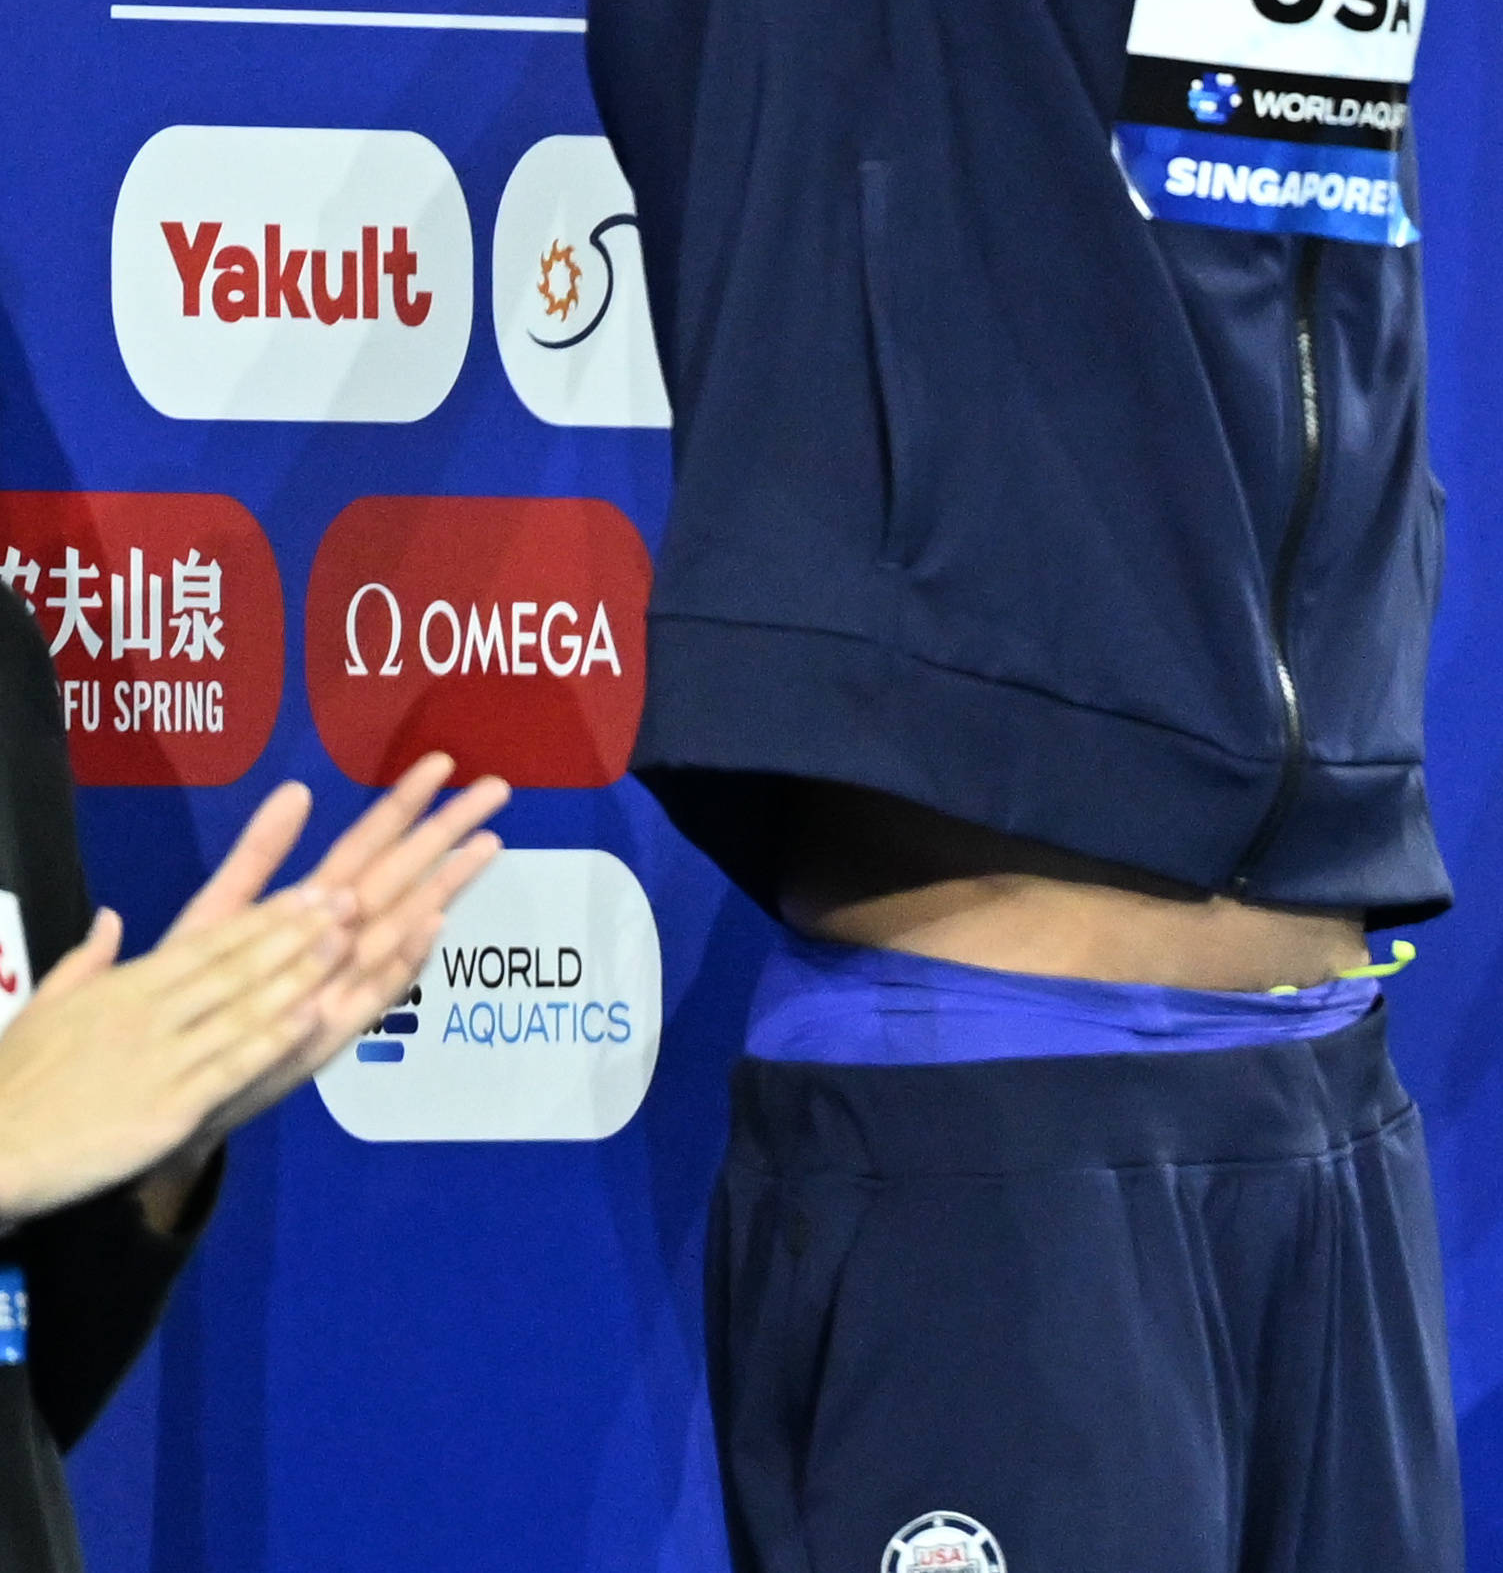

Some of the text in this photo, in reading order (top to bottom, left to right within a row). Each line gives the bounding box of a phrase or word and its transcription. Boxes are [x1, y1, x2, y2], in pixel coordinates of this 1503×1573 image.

[1165, 157, 1390, 215] SINGAPORE
[160, 221, 432, 326] Yakult
[419, 600, 622, 677] OMEGA
[113, 680, 224, 732] SPRING
[442, 946, 582, 989] WORLD
[442, 1002, 632, 1045] AQUATICS
